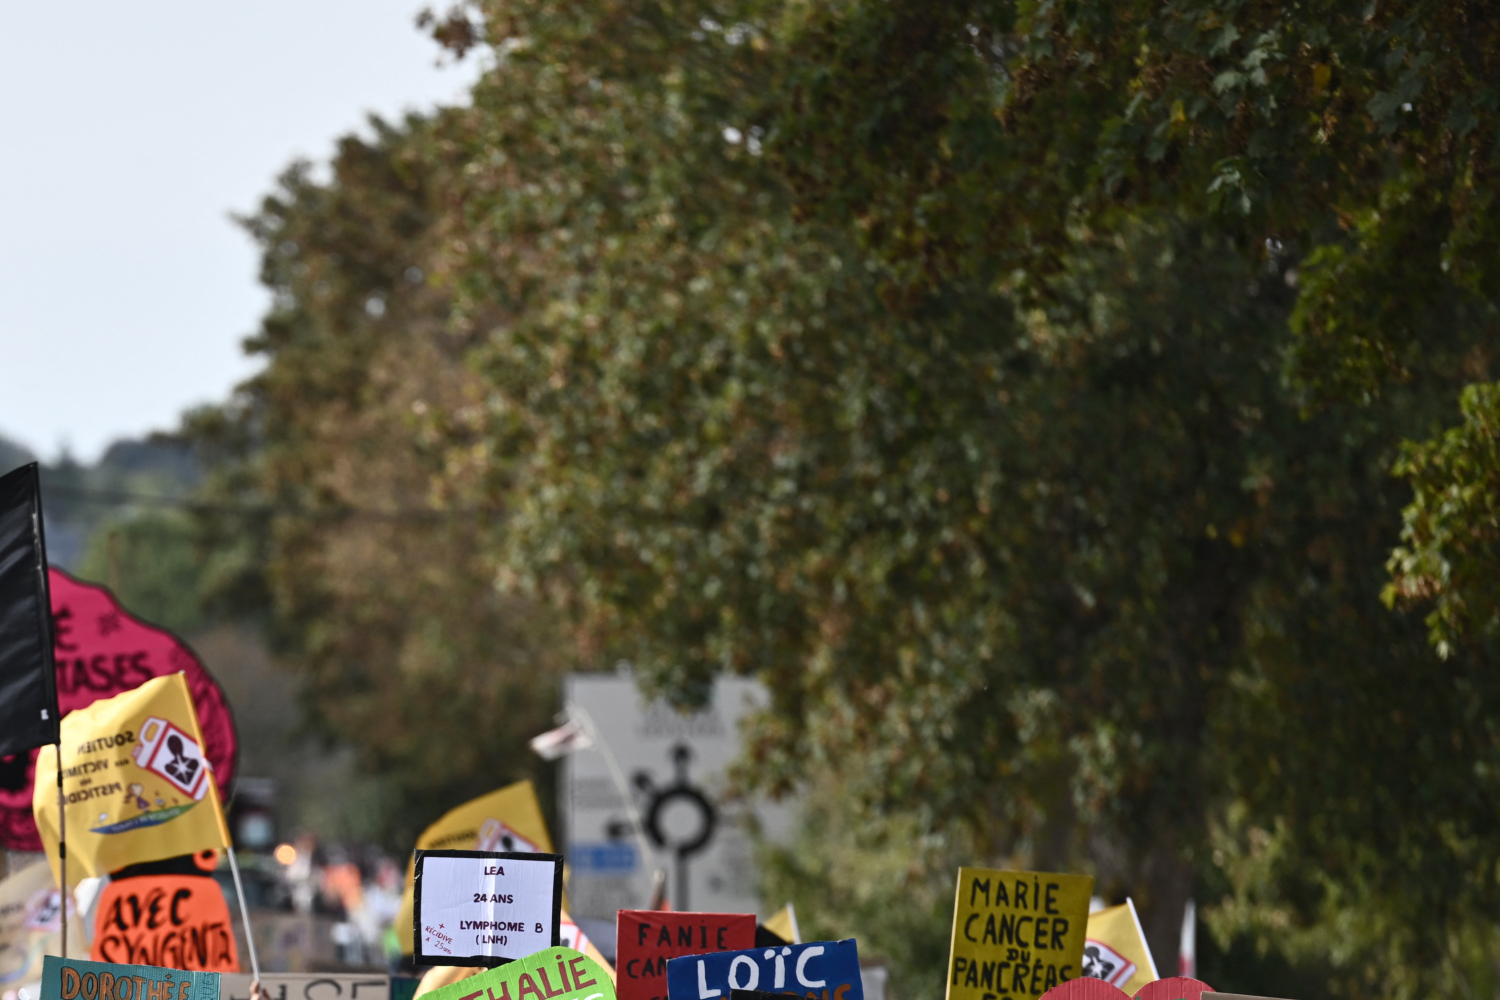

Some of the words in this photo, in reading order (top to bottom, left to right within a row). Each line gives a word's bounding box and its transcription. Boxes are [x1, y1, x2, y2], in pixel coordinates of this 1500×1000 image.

[484, 866, 505, 876] LEA
[102, 887, 192, 932] AVEC
[473, 893, 487, 903] 24
[490, 893, 514, 904] ANS
[970, 875, 1060, 915] MARIE
[460, 920, 525, 932] LYMPHOME
[535, 923, 543, 933] B
[638, 919, 729, 949] FANIE
[964, 912, 1069, 950] CANCER
[626, 958, 667, 979] CAN
[1006, 948, 1031, 963] DU
[697, 945, 826, 1000] LOÏC
[953, 956, 1073, 996] PANCRÉAS
